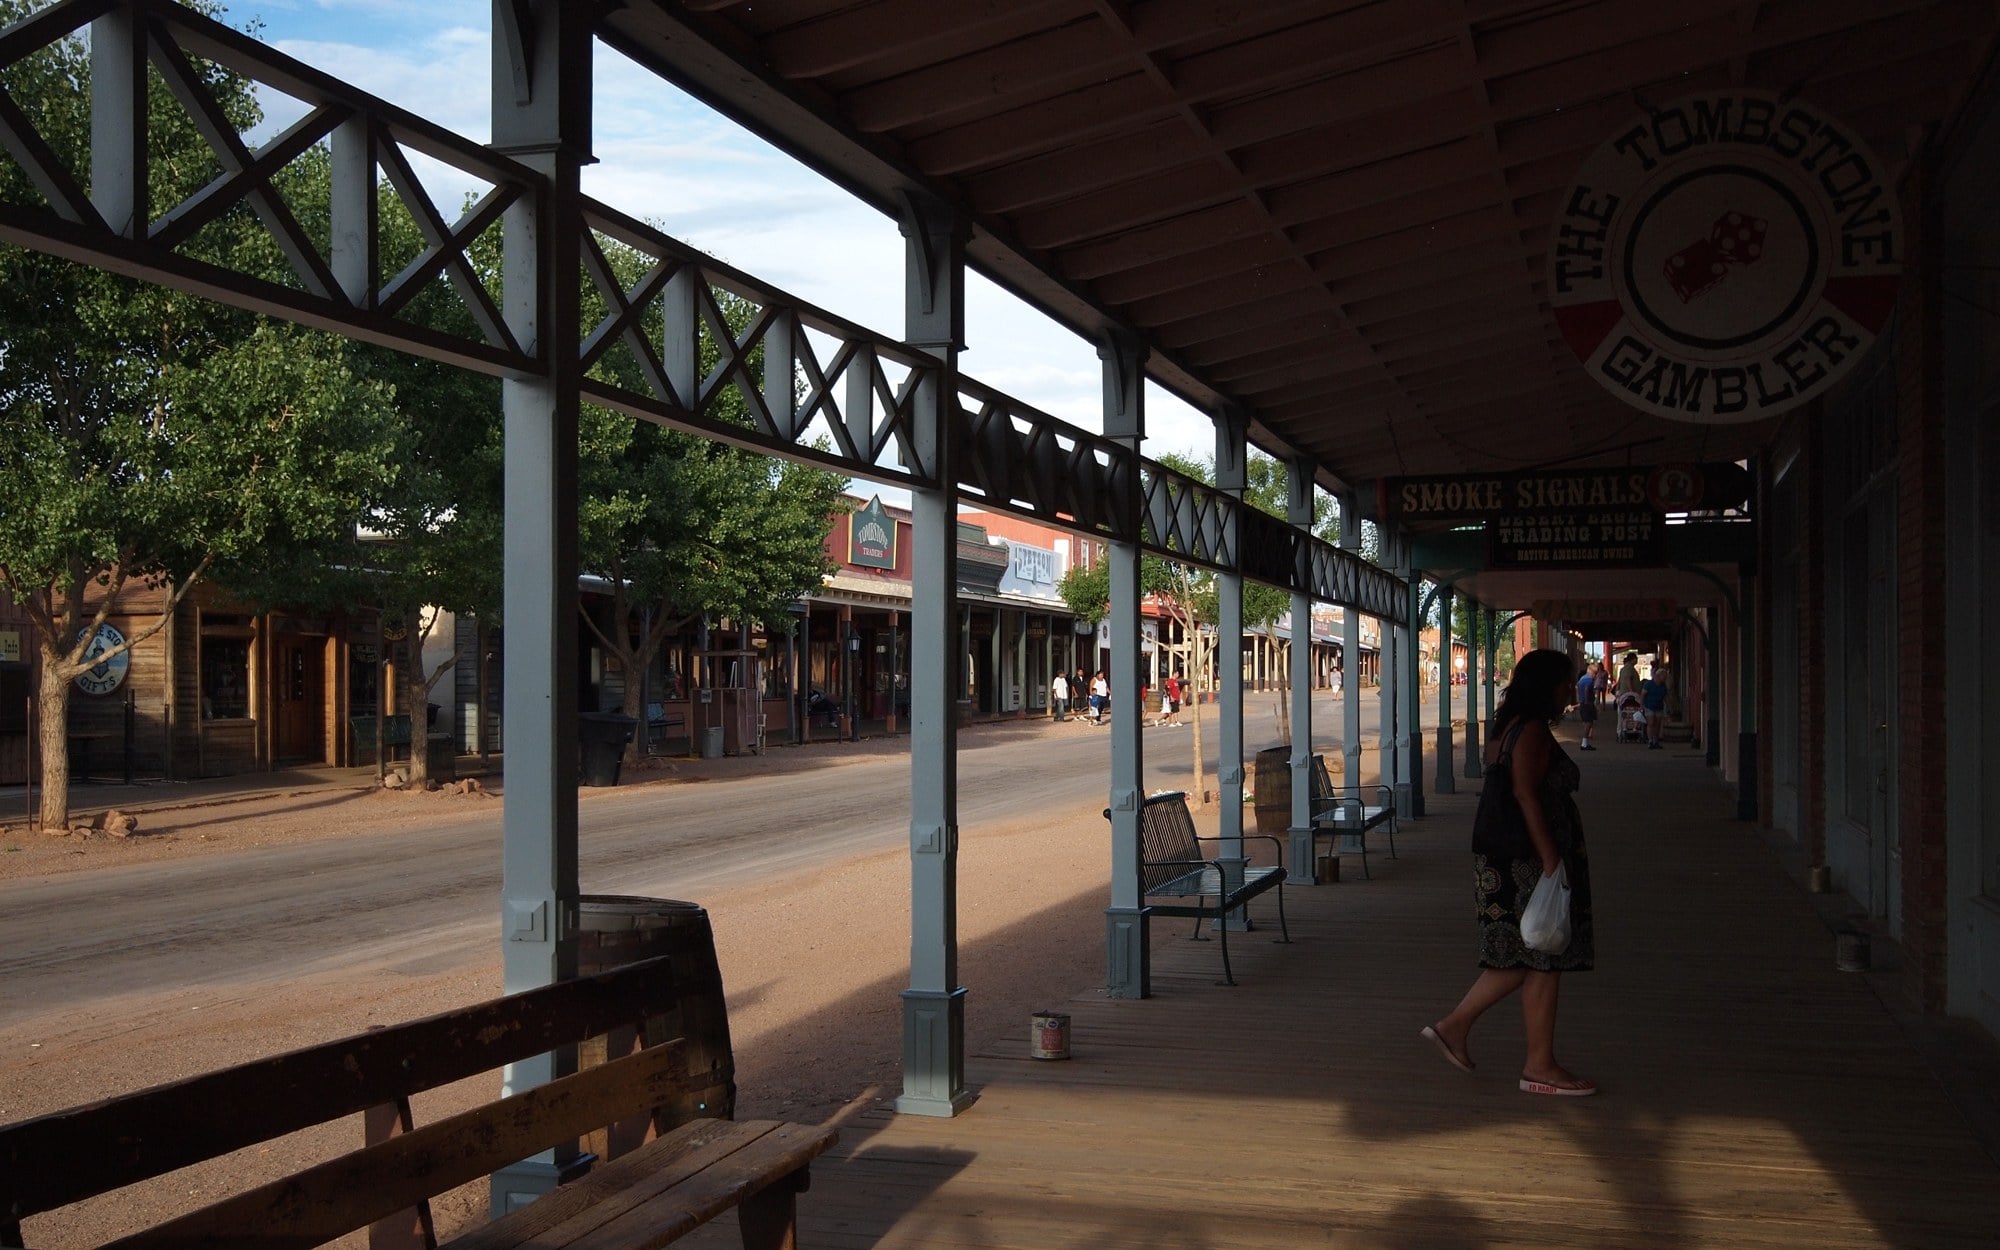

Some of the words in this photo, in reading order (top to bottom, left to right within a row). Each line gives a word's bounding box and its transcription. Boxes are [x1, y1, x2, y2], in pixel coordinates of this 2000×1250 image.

[1556, 185, 1619, 293] THE
[1615, 96, 1893, 268] TOMBSTONE
[1601, 316, 1859, 414] GAMBLER
[1402, 479, 1504, 513] SMOKE
[1515, 475, 1647, 509] SIGNALS
[1499, 526, 1591, 544] TRADING
[1600, 525, 1653, 542] POST
[862, 547, 884, 558] TRADERS
[1019, 547, 1051, 577] STETSON
[1517, 549, 1549, 561] NATIVE
[1552, 548, 1600, 561] AMERICAN
[1602, 547, 1634, 560] OWNED
[80, 676, 116, 691] GIFTS
